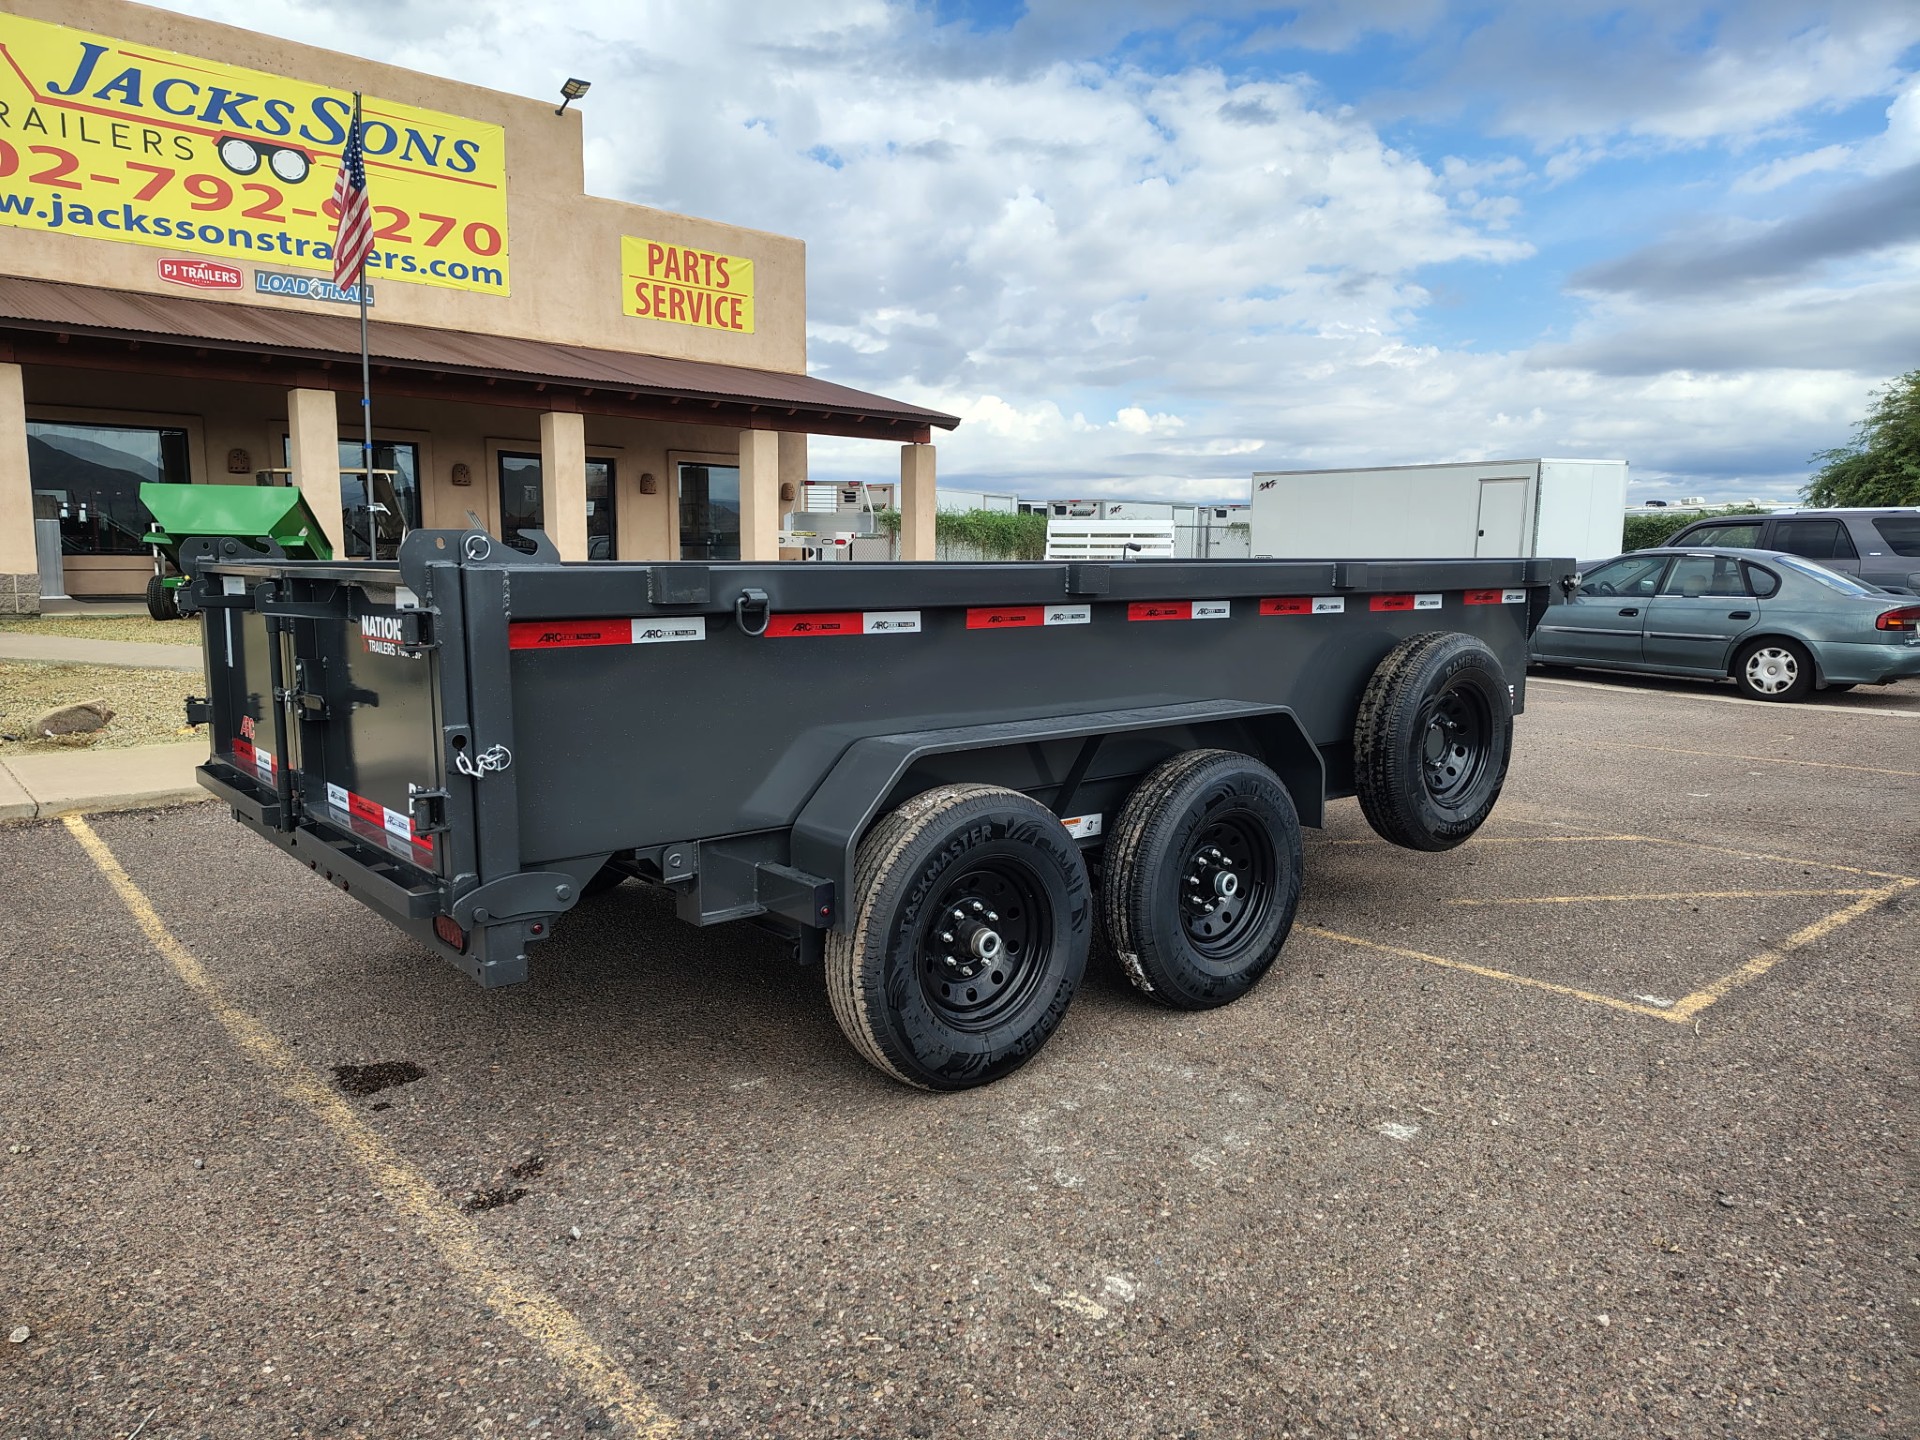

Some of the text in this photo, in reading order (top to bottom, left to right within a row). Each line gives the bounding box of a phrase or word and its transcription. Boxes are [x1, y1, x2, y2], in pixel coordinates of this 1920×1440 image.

[0, 193, 503, 286] w.jackssonstraers.com
[164, 263, 238, 284] PJ TRAILERS
[648, 243, 730, 289] PARTS
[256, 273, 310, 296] LOAD
[635, 282, 743, 330] SERVICE
[640, 629, 663, 639] ARC
[792, 622, 811, 631] ARC
[871, 620, 890, 630] ARC
[368, 639, 396, 656] TRAILERS
[537, 632, 562, 643] ARC
[1445, 655, 1487, 678] RAMBLER
[901, 825, 993, 935] TASKMASTER
